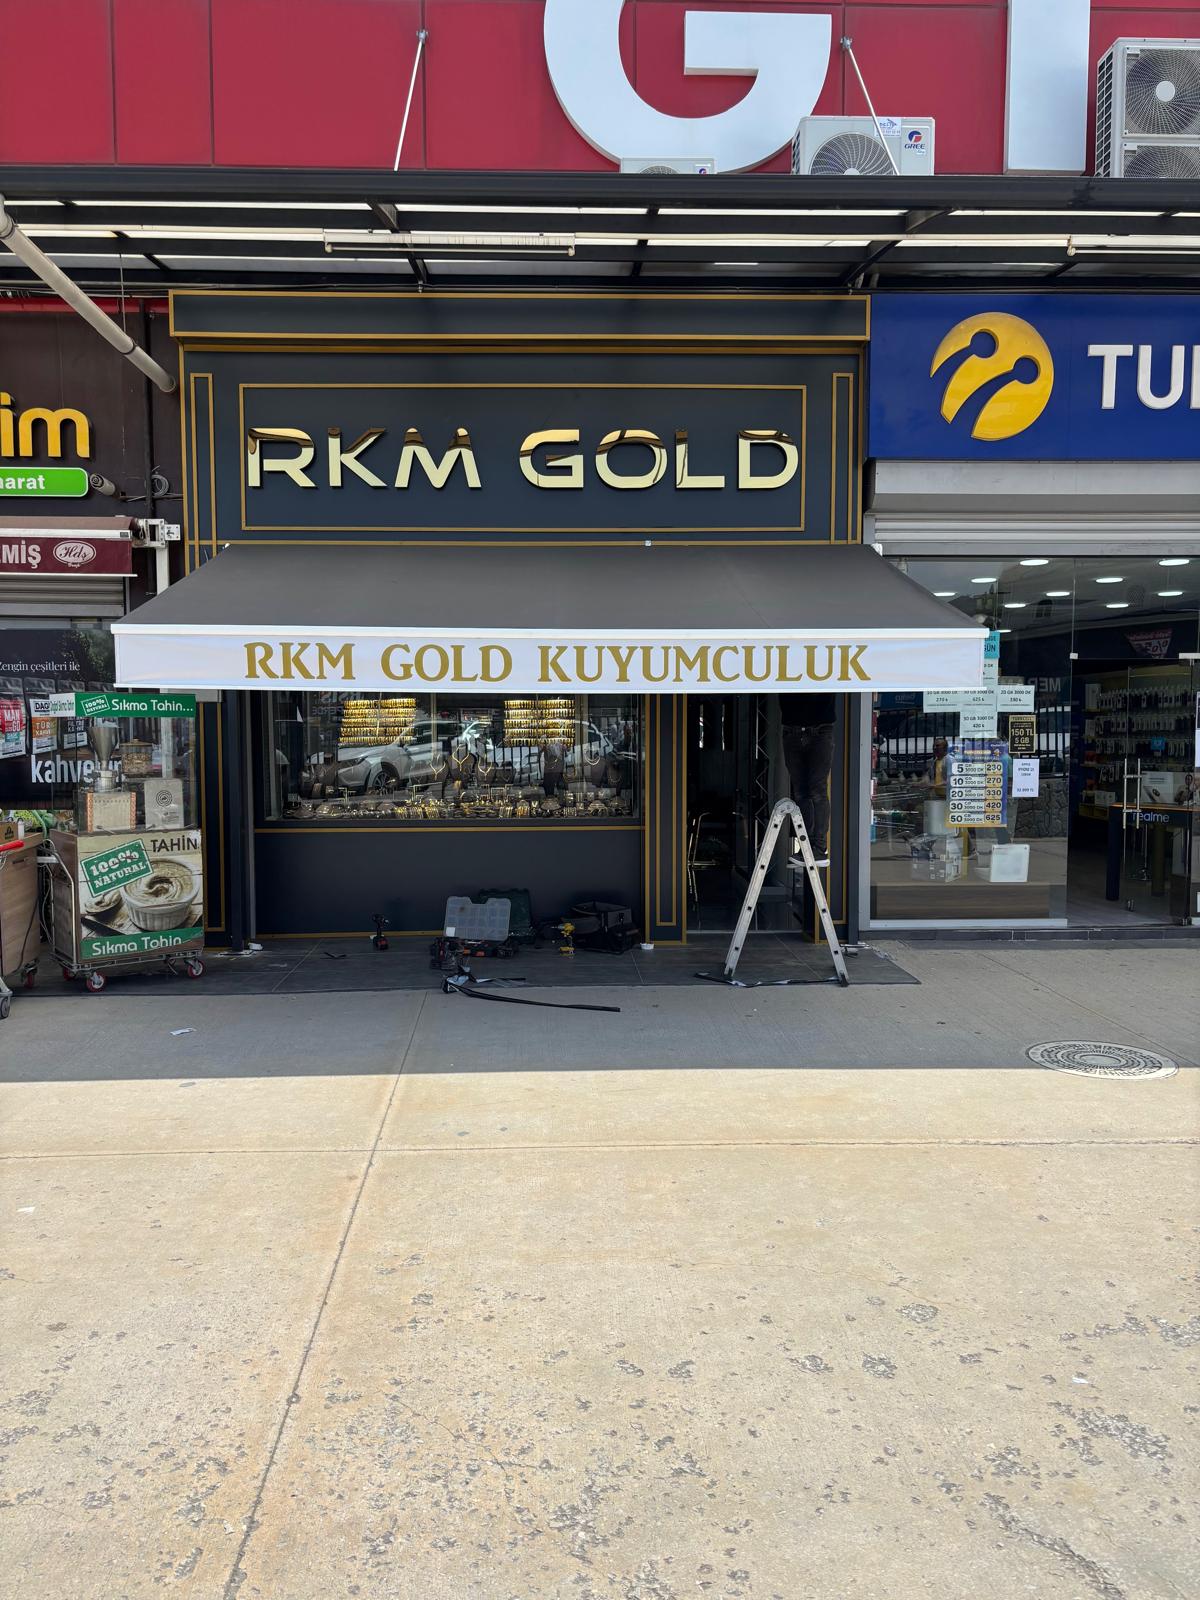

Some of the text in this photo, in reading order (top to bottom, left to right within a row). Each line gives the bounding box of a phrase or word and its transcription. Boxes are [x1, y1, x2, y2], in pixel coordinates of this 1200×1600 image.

[1088, 344, 1200, 410] TU
[247, 427, 799, 489] RKM GOLD
[0, 474, 46, 490] arat
[0, 540, 42, 569] MİŞ
[30, 661, 67, 673] çeşitleri
[69, 661, 81, 671] ile
[243, 642, 872, 683] RKM GOLD KUYUMCULUK
[111, 699, 148, 711] Sıkma
[1011, 728, 1034, 736] 150 TL
[1020, 736, 1030, 744] GB
[957, 763, 964, 773] 5
[953, 777, 964, 785] 10
[951, 790, 964, 798] 20
[950, 802, 963, 810] 30
[950, 814, 963, 823] 50
[1133, 812, 1170, 823] realme
[90, 849, 140, 877] 100%
[94, 862, 147, 888] NATURAL
[92, 941, 138, 956] Sıkma
